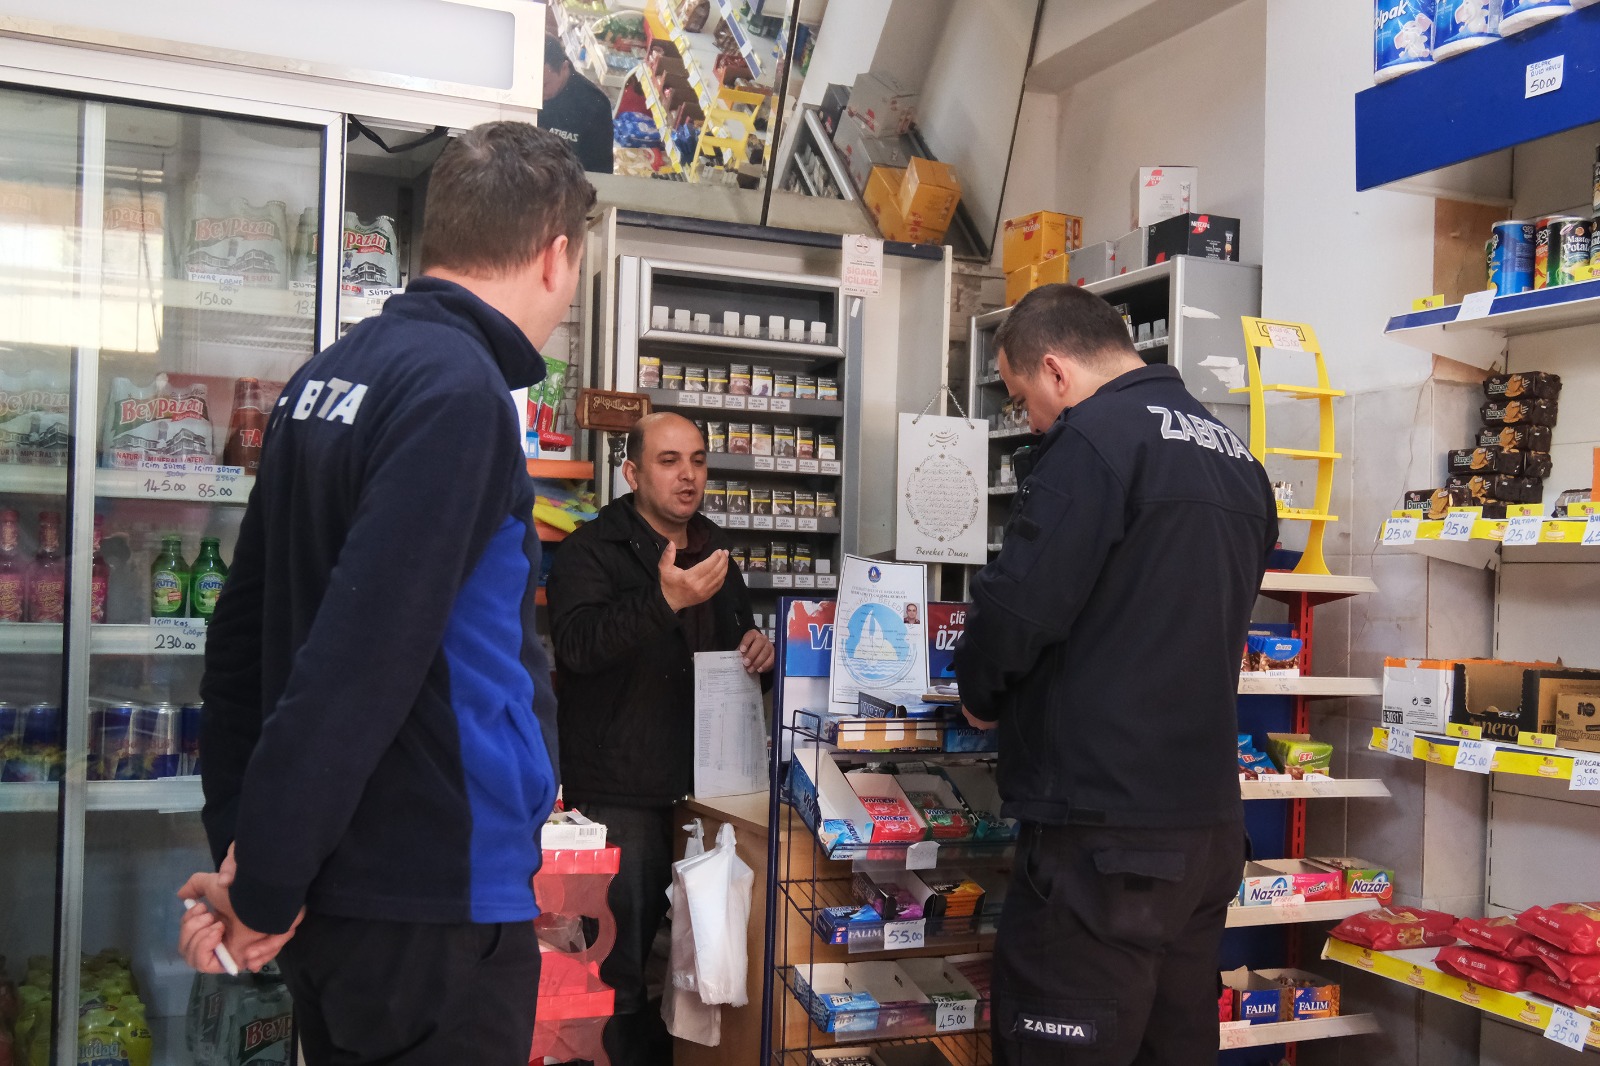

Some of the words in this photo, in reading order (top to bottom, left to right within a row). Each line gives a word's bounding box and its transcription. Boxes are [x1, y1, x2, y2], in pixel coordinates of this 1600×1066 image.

[195, 291, 233, 306] 150.00
[120, 398, 204, 425] Beypazarı
[1146, 405, 1254, 462] ZABITA
[144, 478, 187, 493] 145.00
[198, 483, 233, 497] 85.00
[1385, 527, 1412, 540] 25.00
[915, 546, 944, 556] Bereket
[947, 547, 969, 558] Duası
[154, 633, 196, 650] 230.00
[808, 623, 834, 650] Vi
[1481, 720, 1519, 737] nero
[1389, 738, 1411, 754] 25.00
[1457, 752, 1487, 766] 25.00
[1350, 879, 1389, 894] Nazar
[888, 929, 923, 944] 55.00
[1246, 1004, 1276, 1014] FALIM
[1299, 1001, 1329, 1011] FALIM
[939, 1015, 967, 1029] 45.00
[1023, 1018, 1085, 1038] ZABITA
[1549, 1024, 1580, 1043] 35.00
